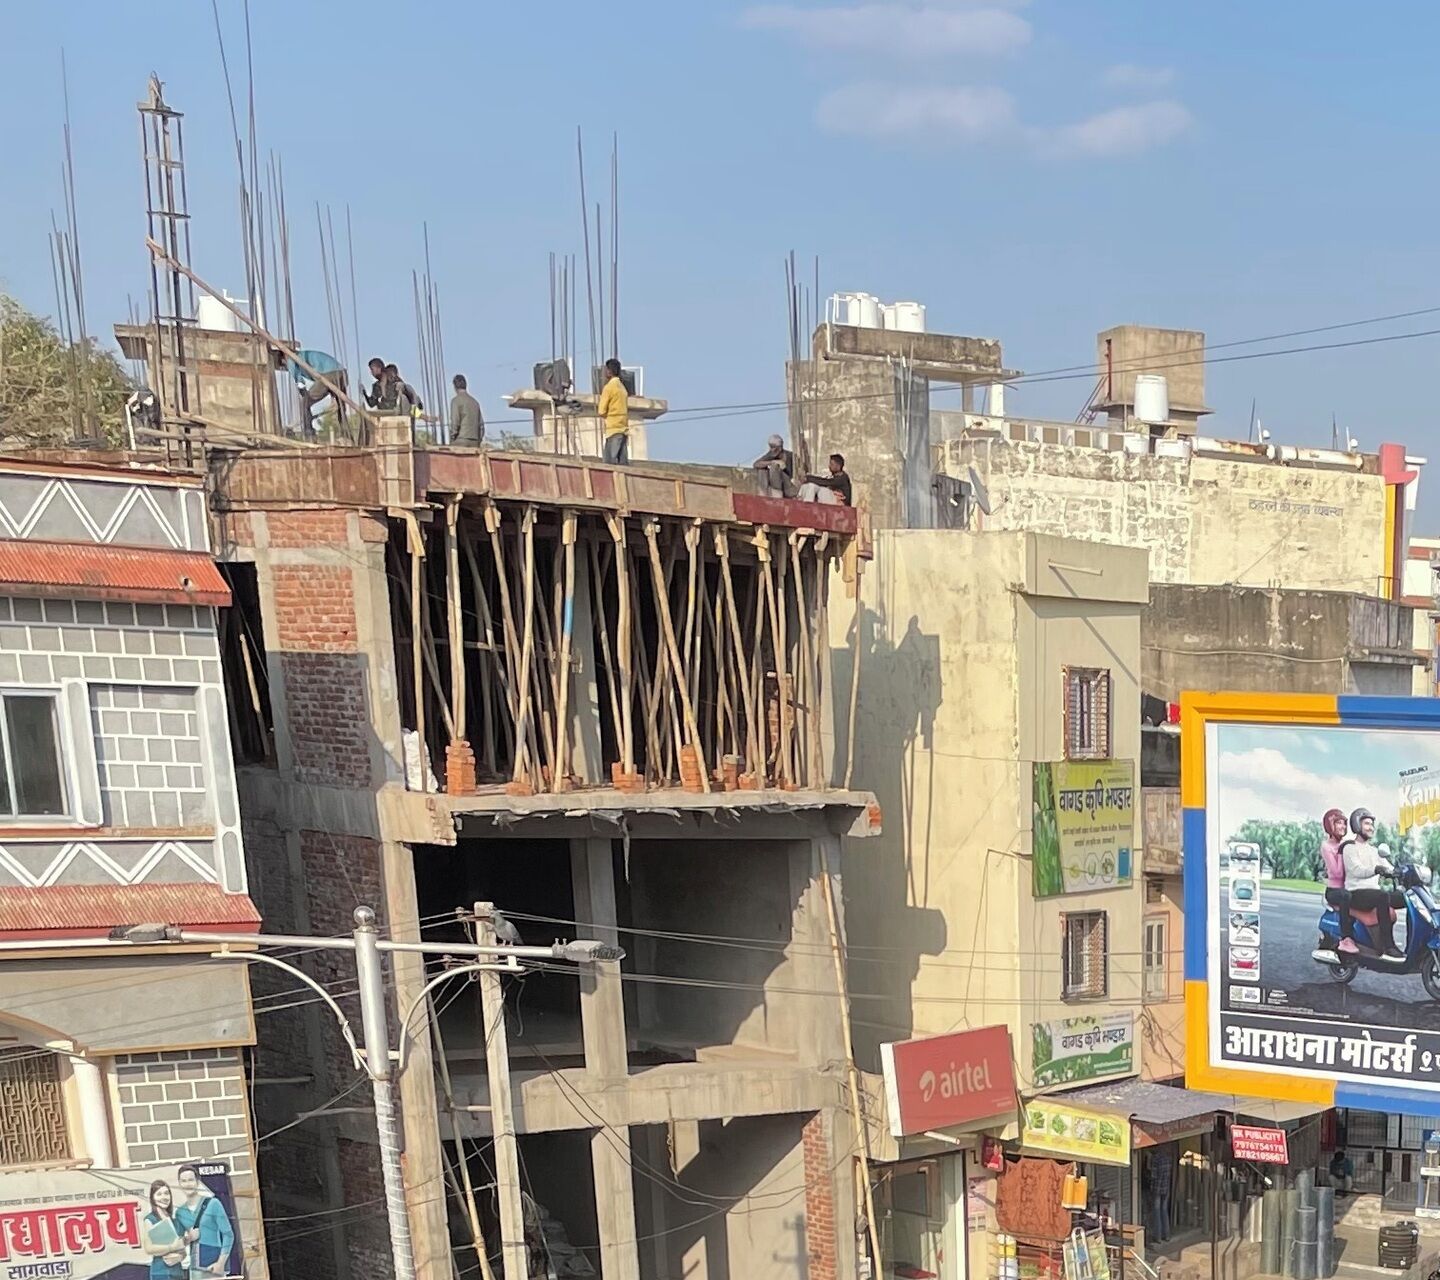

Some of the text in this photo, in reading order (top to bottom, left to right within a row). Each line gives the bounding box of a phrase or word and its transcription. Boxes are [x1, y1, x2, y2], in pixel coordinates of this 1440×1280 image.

[1225, 1025, 1338, 1065] आराधना
[1340, 1030, 1417, 1074] मोटर्स
[940, 1057, 992, 1099] airtel
